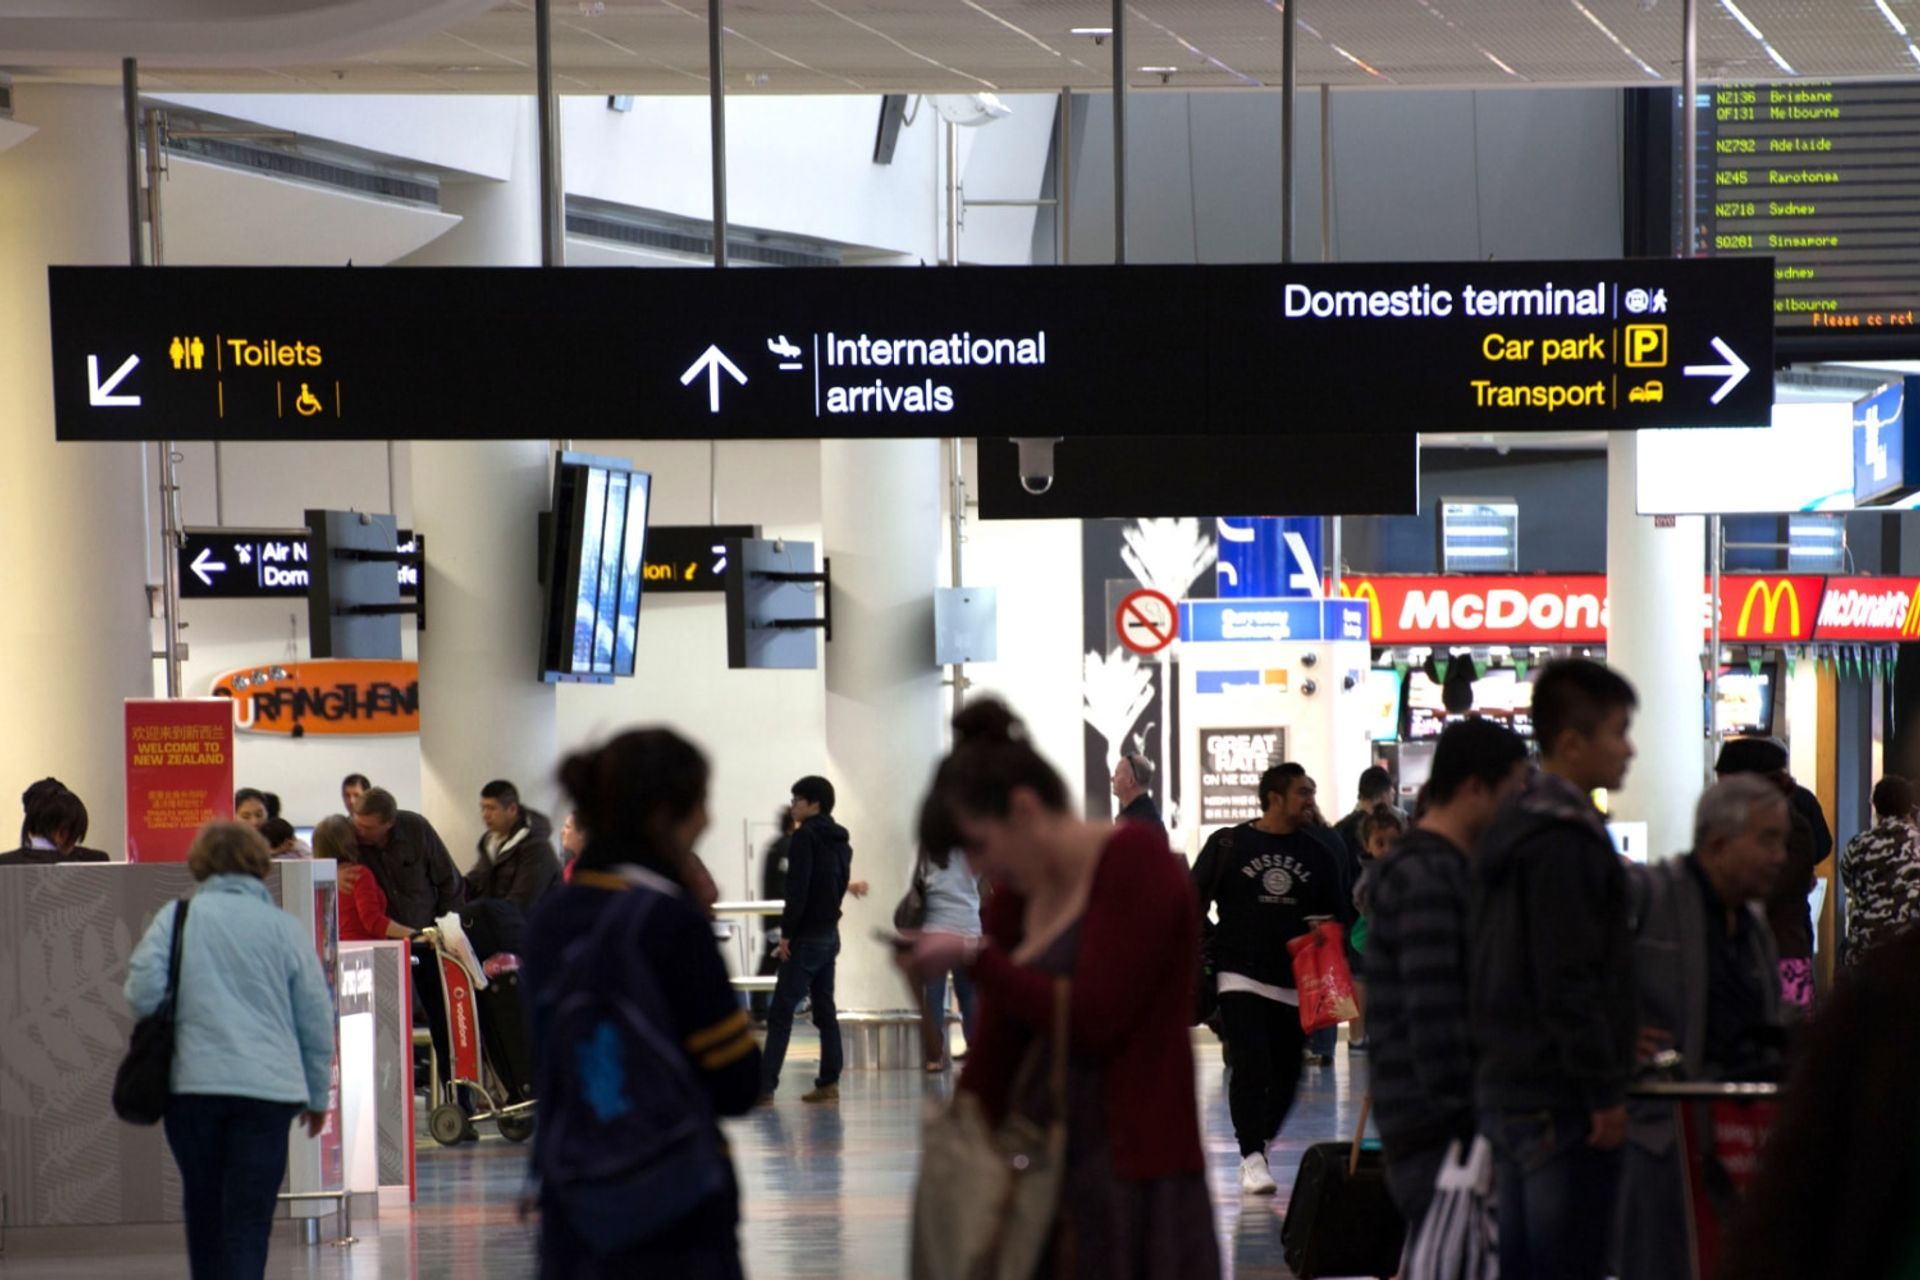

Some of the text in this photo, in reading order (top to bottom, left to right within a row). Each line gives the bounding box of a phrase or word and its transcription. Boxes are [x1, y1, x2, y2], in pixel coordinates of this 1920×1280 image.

[1769, 90, 1832, 103] Brisbane
[1769, 107, 1840, 119] Melbourne
[1769, 138, 1832, 151] Adelaide
[1716, 171, 1748, 184] NZ45
[1769, 202, 1816, 215] Sydney
[1775, 267, 1815, 279] ydney
[1284, 281, 1606, 318] Domestic terminal
[1774, 299, 1838, 311] elbourne
[227, 339, 322, 367] Toilets
[826, 331, 1046, 366] International
[1482, 333, 1605, 365] Car park
[826, 378, 954, 413] arrivals
[1471, 380, 1605, 411] Transport
[262, 541, 291, 562] Air
[137, 742, 220, 754] WELCOME TO
[1207, 735, 1278, 754] GREAT
[133, 753, 225, 766] NEW ZEALAND
[1241, 854, 1313, 884] RUSSELL
